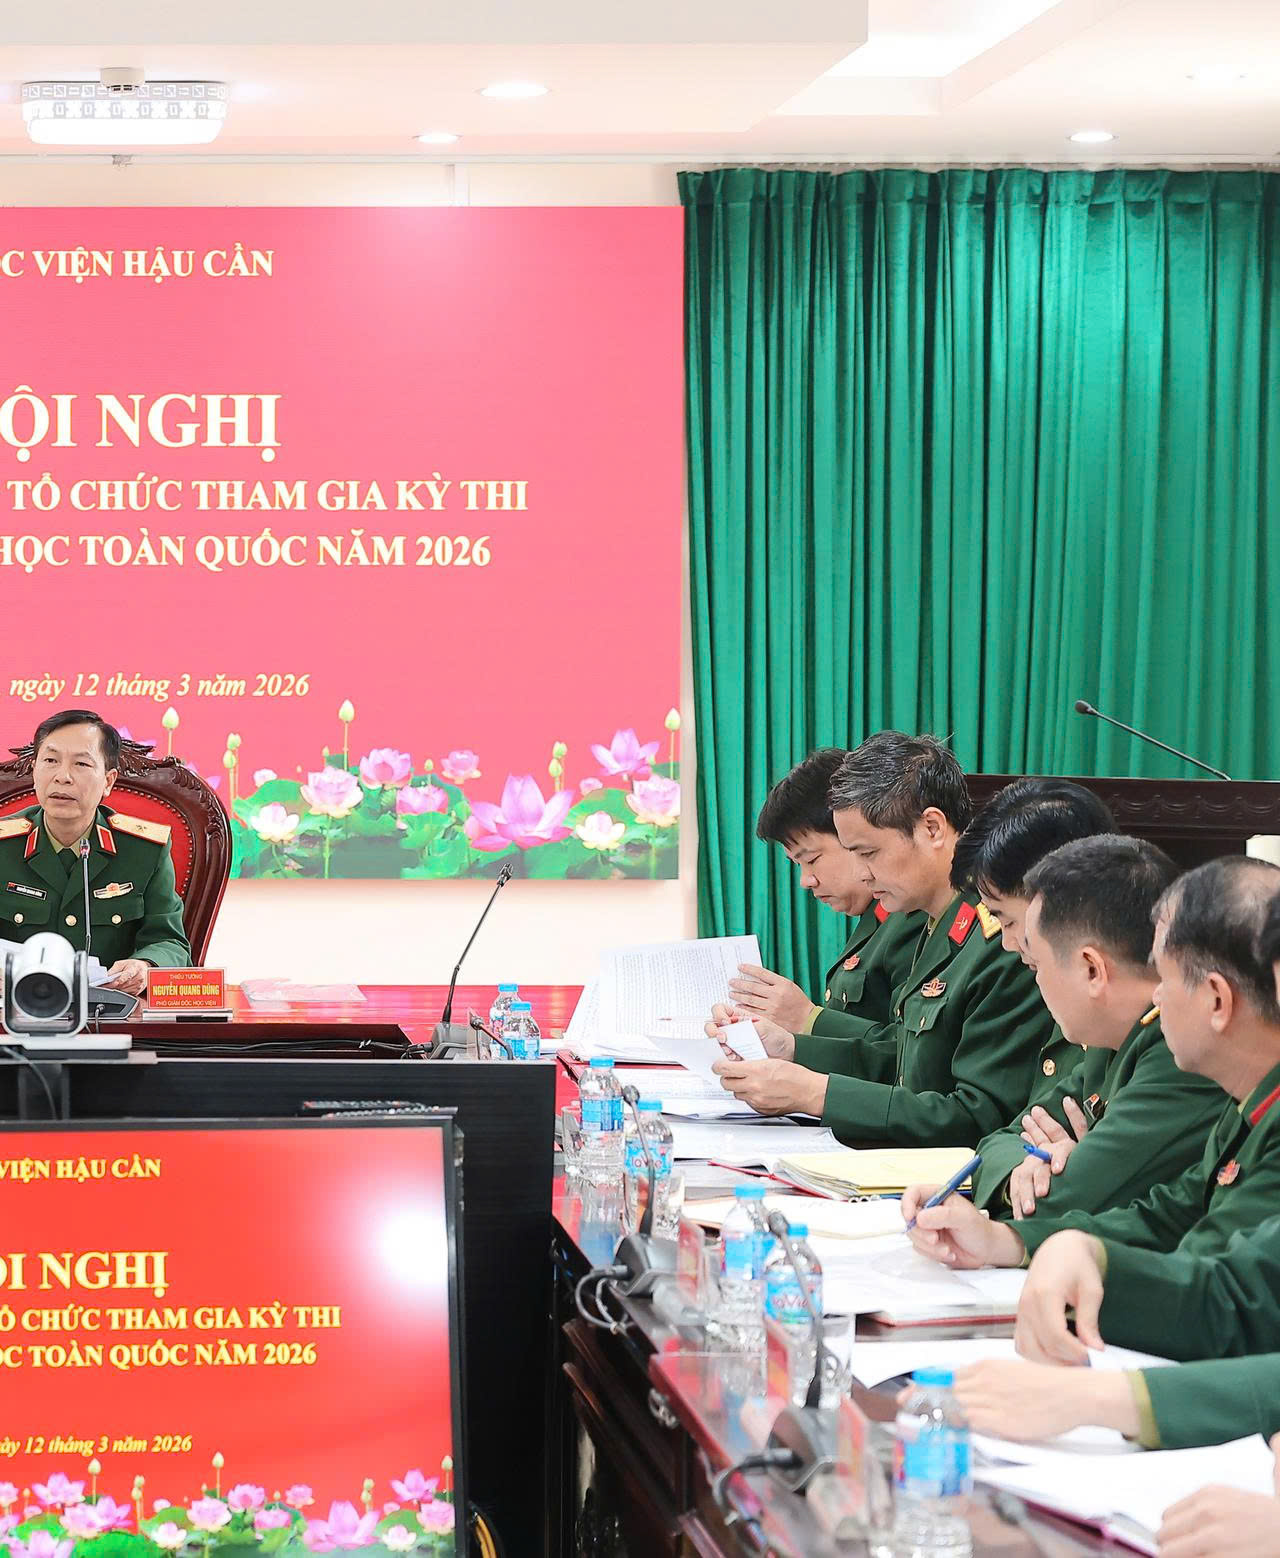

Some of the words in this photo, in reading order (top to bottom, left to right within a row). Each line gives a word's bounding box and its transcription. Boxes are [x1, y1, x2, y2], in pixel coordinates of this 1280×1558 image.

[31, 246, 114, 284] VIỆN
[122, 246, 195, 284] HẬU
[203, 242, 274, 277] CẦN
[95, 393, 282, 463] NGHỊ
[6, 472, 61, 511] TỔ
[69, 471, 183, 511] CHỨC
[191, 480, 308, 511] THAM
[317, 479, 388, 511] GIA
[395, 471, 452, 511] KỲ
[459, 480, 529, 511] THI
[78, 527, 186, 566] TOÀN
[195, 527, 307, 572] QUỐC
[316, 528, 407, 566] NĂM
[415, 535, 491, 567] 2026
[9, 672, 66, 702] ngày
[72, 673, 100, 696] 12
[105, 672, 171, 703] tháng
[176, 673, 191, 697] 3
[197, 673, 246, 697] năm
[252, 673, 310, 697] 2026
[55, 1156, 107, 1183] HẬU
[111, 1153, 161, 1179] CẦN
[37, 1251, 170, 1299] NGHỊ
[20, 1303, 101, 1331] CHỨC
[105, 1307, 188, 1330] THAM
[192, 1306, 244, 1330] GIA
[248, 1300, 288, 1329] KỲ
[292, 1305, 342, 1329] THI
[27, 1339, 104, 1368] TOÀN
[108, 1338, 189, 1371] QUỐC
[194, 1338, 258, 1366] NĂM
[263, 1342, 318, 1365] 2026
[24, 1436, 45, 1455] 12
[48, 1435, 95, 1457] tháng
[97, 1435, 110, 1454] 3
[111, 1436, 149, 1453] năm
[151, 1434, 194, 1453] 2026
